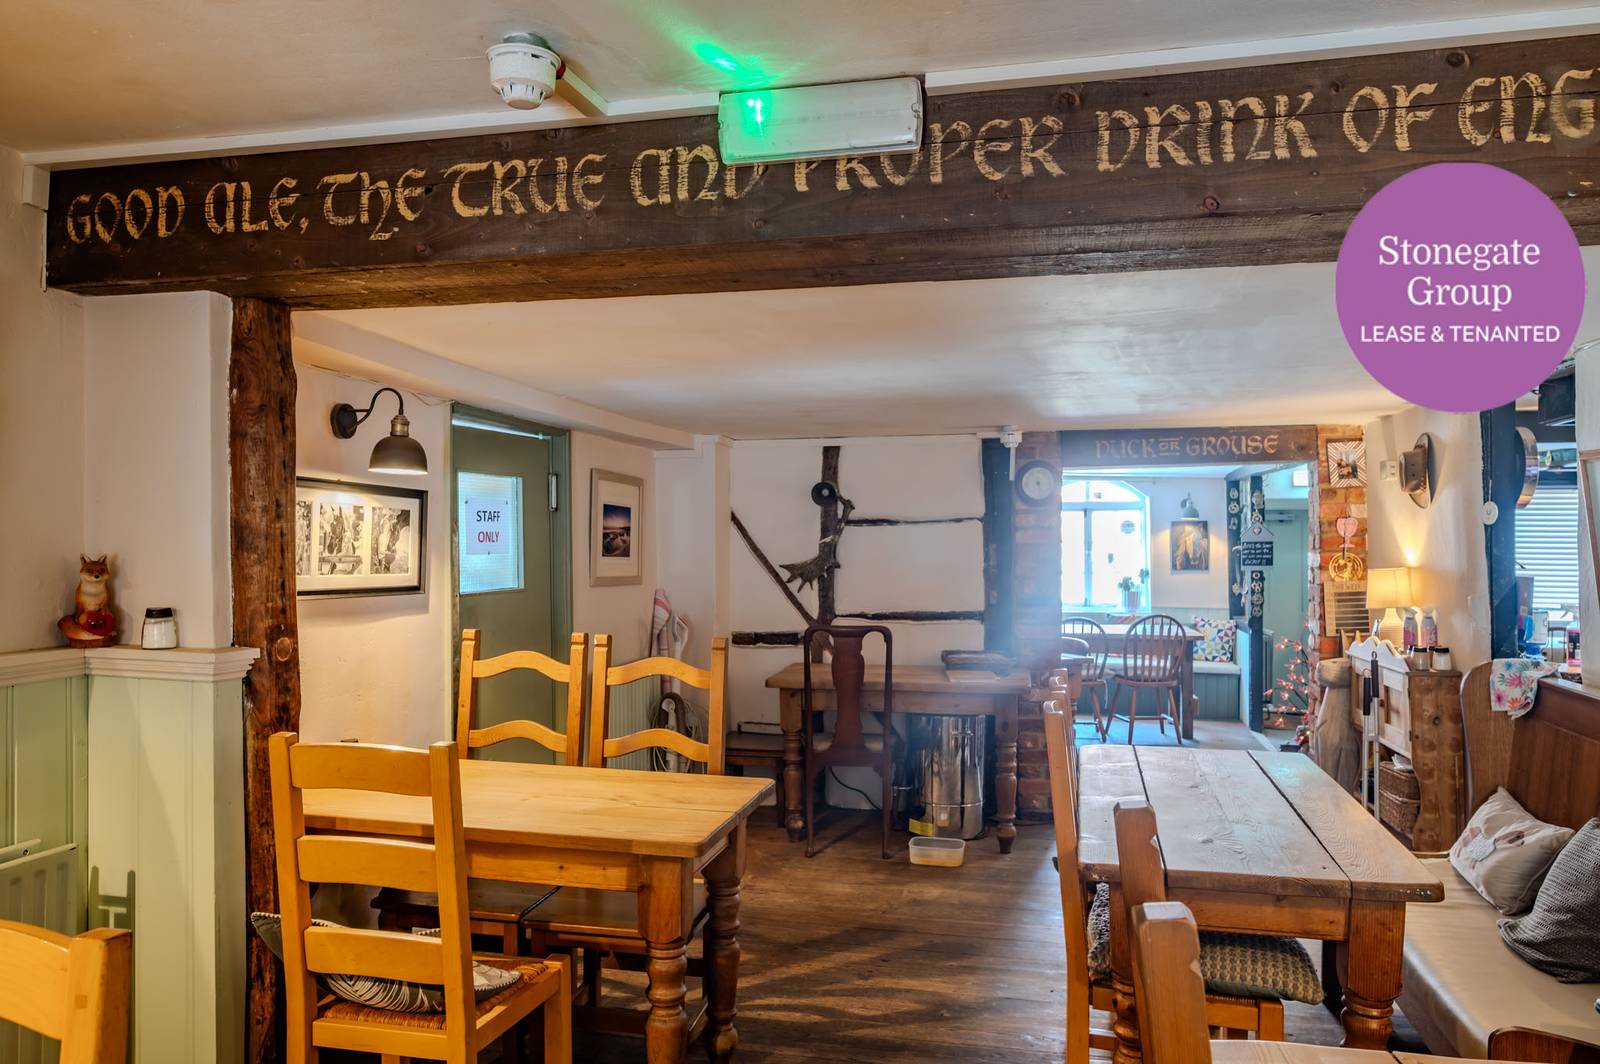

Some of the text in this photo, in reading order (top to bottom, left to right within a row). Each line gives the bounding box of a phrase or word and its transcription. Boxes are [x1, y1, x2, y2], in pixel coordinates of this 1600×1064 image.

[67, 186, 185, 243] GOOD
[205, 177, 309, 236] ALE,
[316, 168, 428, 240] THE
[441, 153, 608, 217] TRUE
[1095, 91, 1318, 172] DRINK
[1343, 82, 1438, 152] OF
[1095, 438, 1157, 459] DUCK
[1186, 435, 1279, 454] GROUSE
[476, 510, 501, 522] STAFF
[477, 531, 500, 543] ONLY
